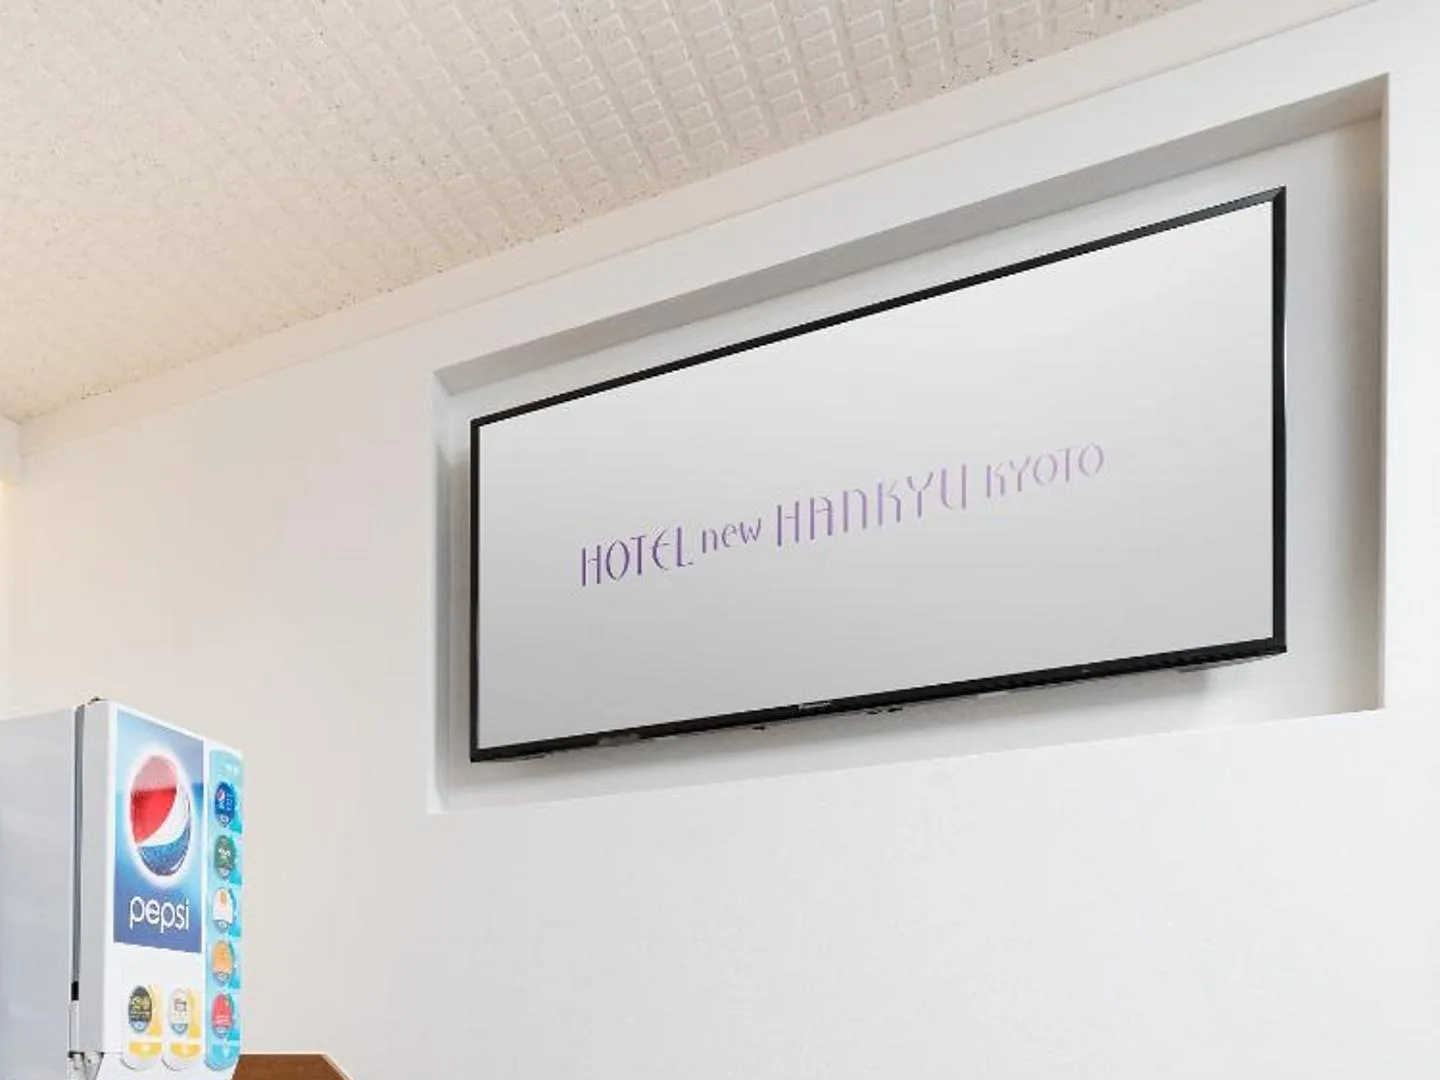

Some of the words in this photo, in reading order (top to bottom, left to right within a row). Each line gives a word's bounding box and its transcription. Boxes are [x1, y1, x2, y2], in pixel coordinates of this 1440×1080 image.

[580, 526, 694, 587] HOTEL
[701, 517, 762, 554] new
[776, 463, 969, 547] HANKYU
[986, 442, 1105, 498] KYOTO
[129, 895, 189, 934] pepsi
